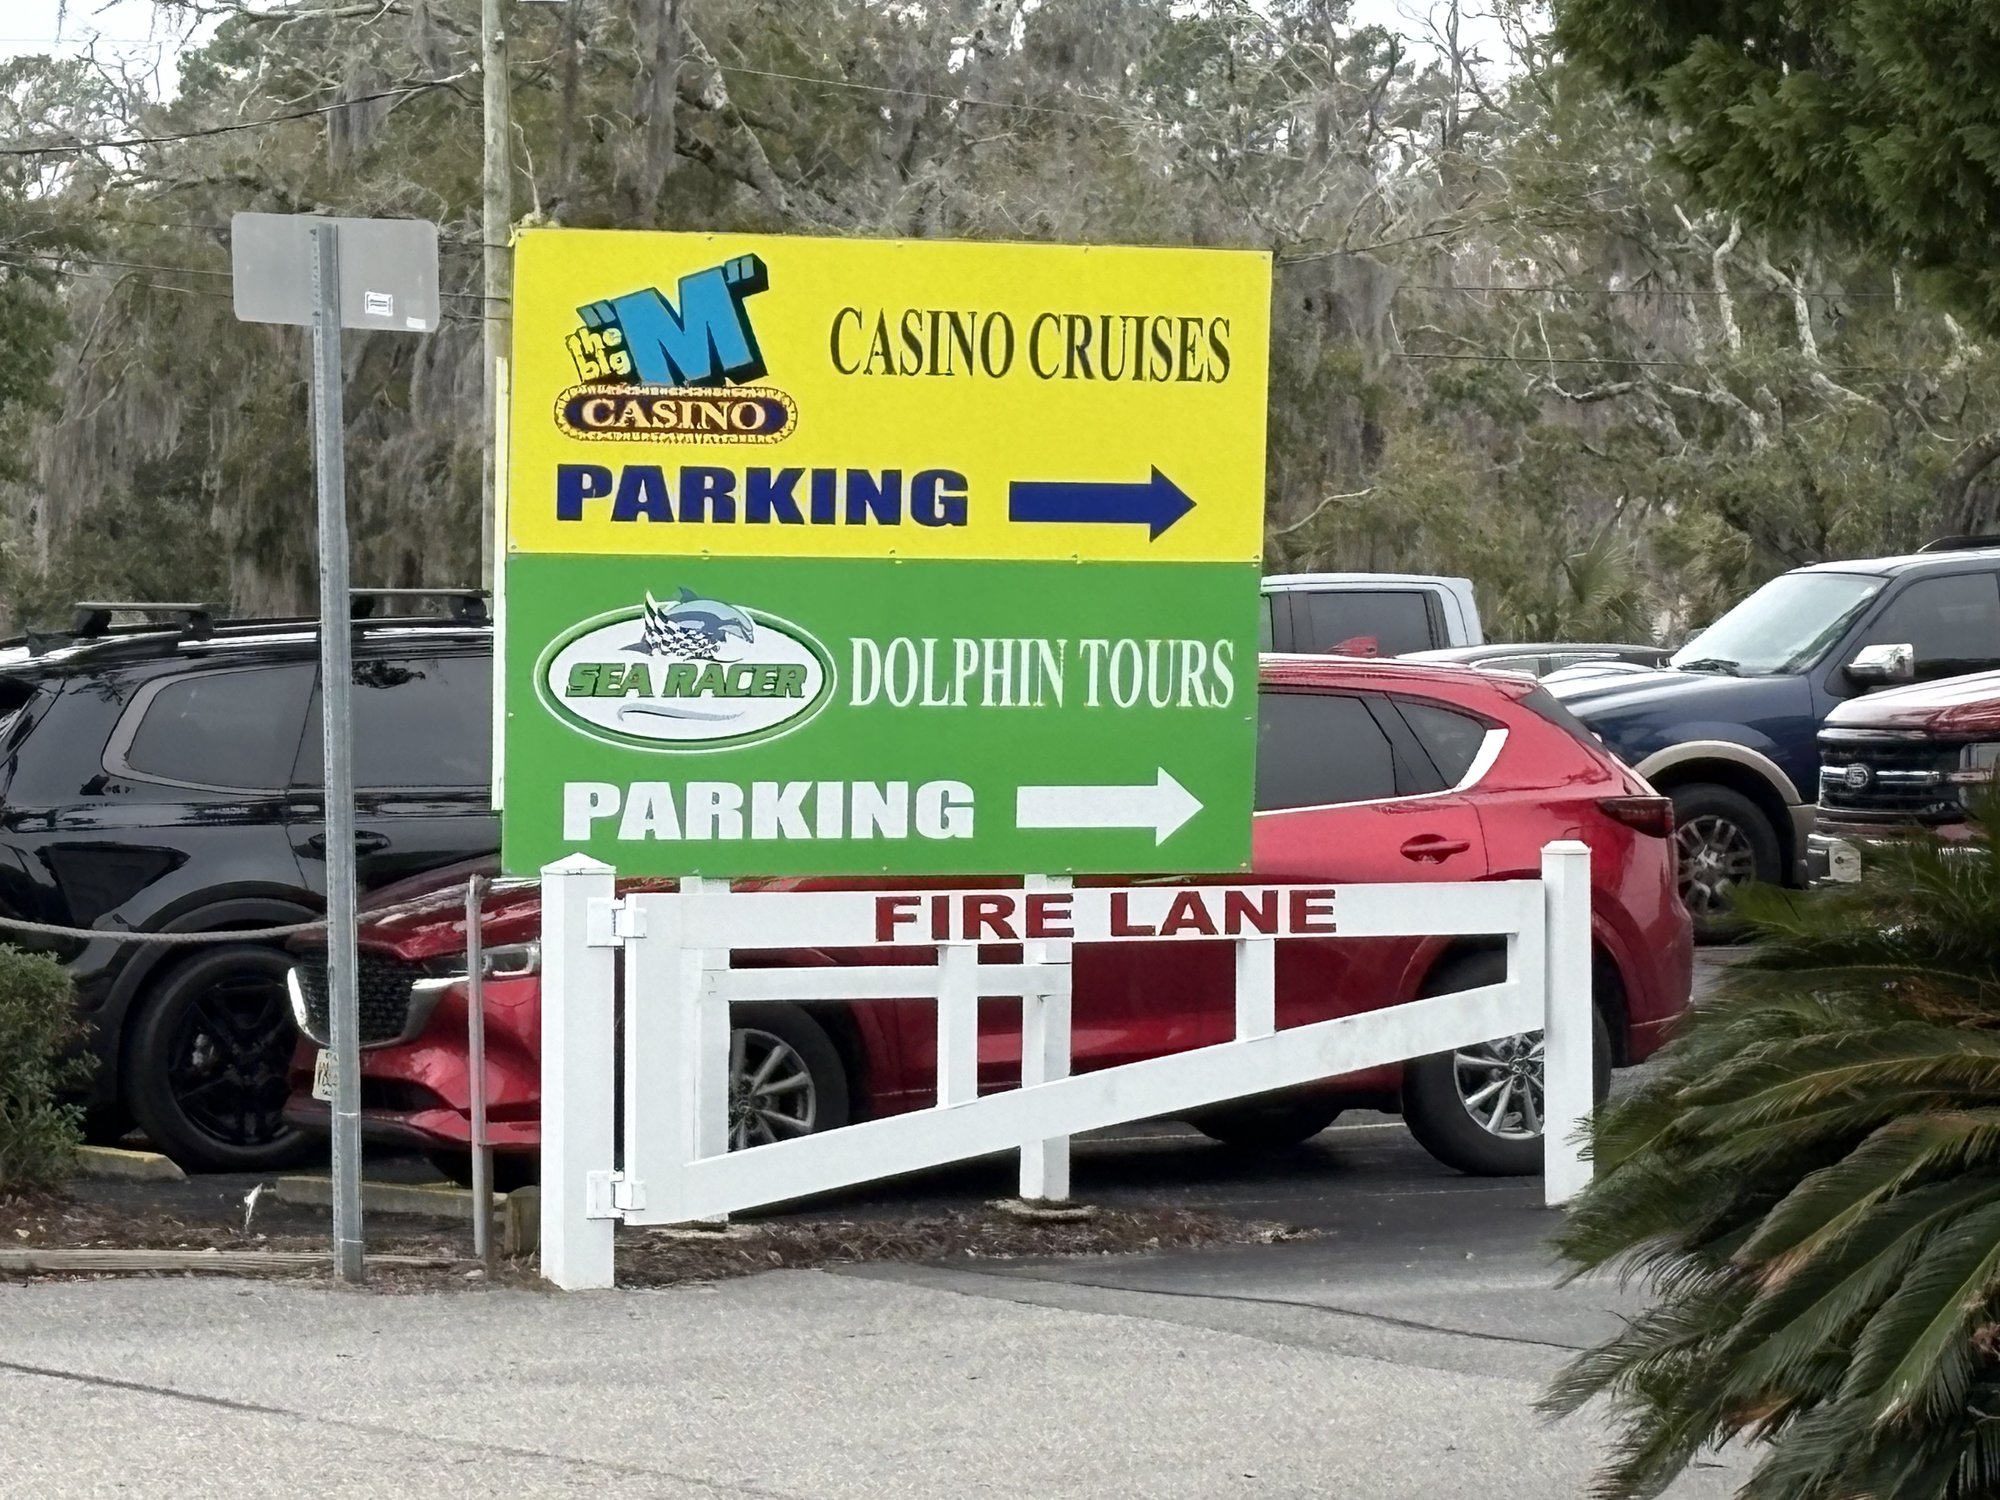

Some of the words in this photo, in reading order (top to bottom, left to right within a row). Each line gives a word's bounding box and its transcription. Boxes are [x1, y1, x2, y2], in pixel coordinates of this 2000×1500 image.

[830, 306, 1015, 378] CASINO
[1029, 312, 1231, 384] CRUISES
[581, 398, 766, 431] CASINO
[557, 463, 968, 527] PARKING
[565, 662, 654, 698] SEA
[660, 662, 808, 698] RACER
[849, 637, 1066, 708] DOLPHIN
[1080, 637, 1235, 710] TOURS
[563, 780, 975, 842] PARKING
[875, 893, 1075, 942] FIRE
[1110, 889, 1337, 938] LANE
